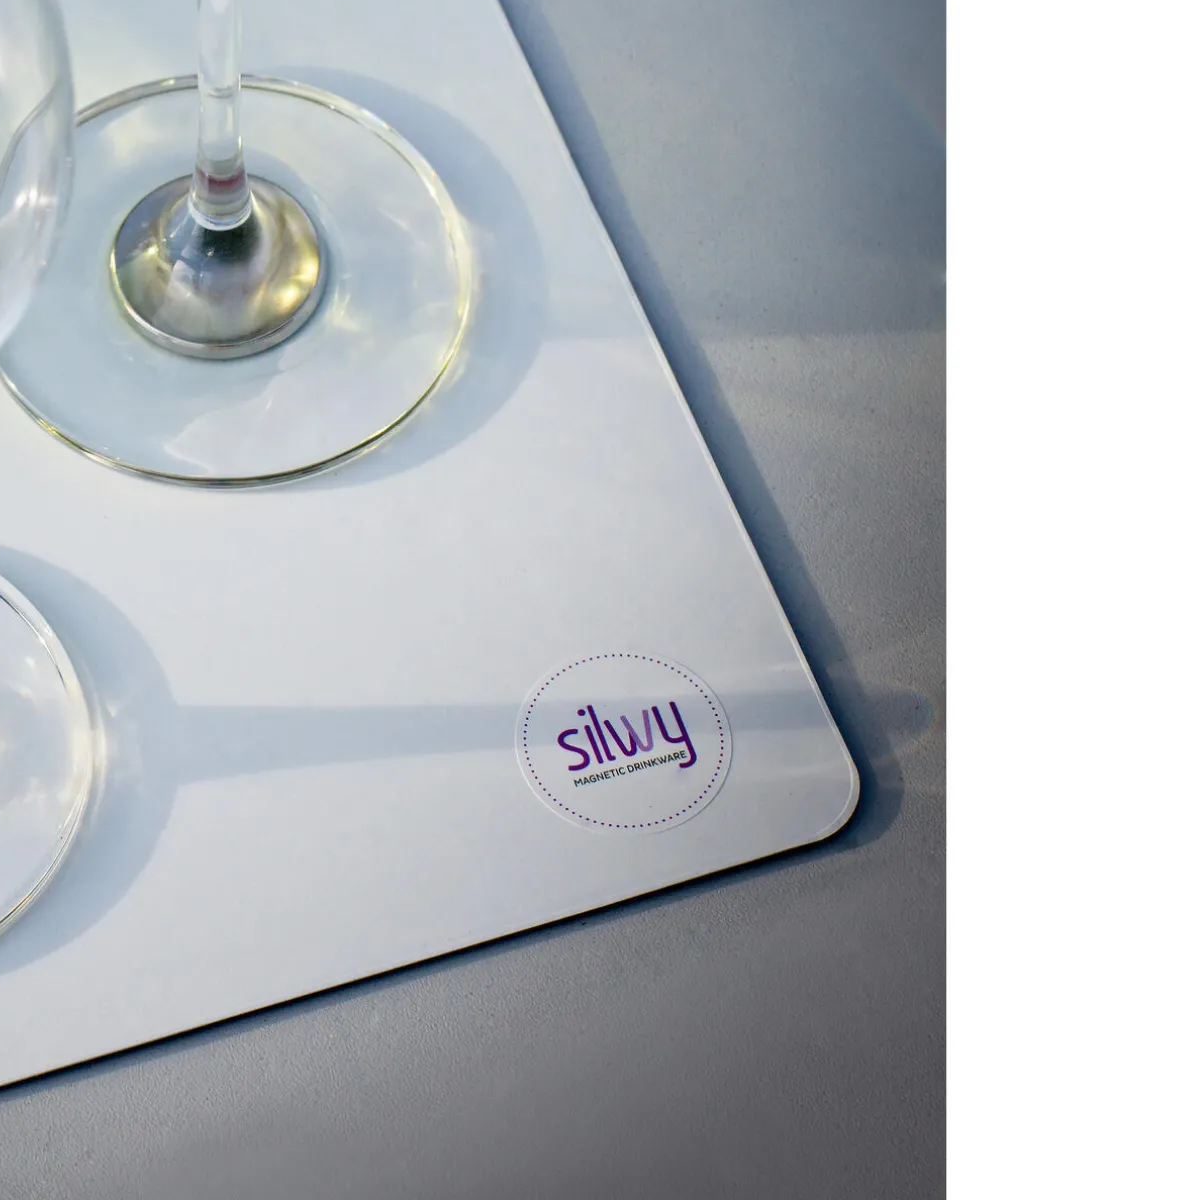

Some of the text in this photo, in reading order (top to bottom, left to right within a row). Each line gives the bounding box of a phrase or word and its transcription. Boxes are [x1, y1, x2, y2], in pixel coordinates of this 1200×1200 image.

[557, 701, 698, 771] silwy
[573, 749, 688, 788] MAGNETIC DRINKWARE
